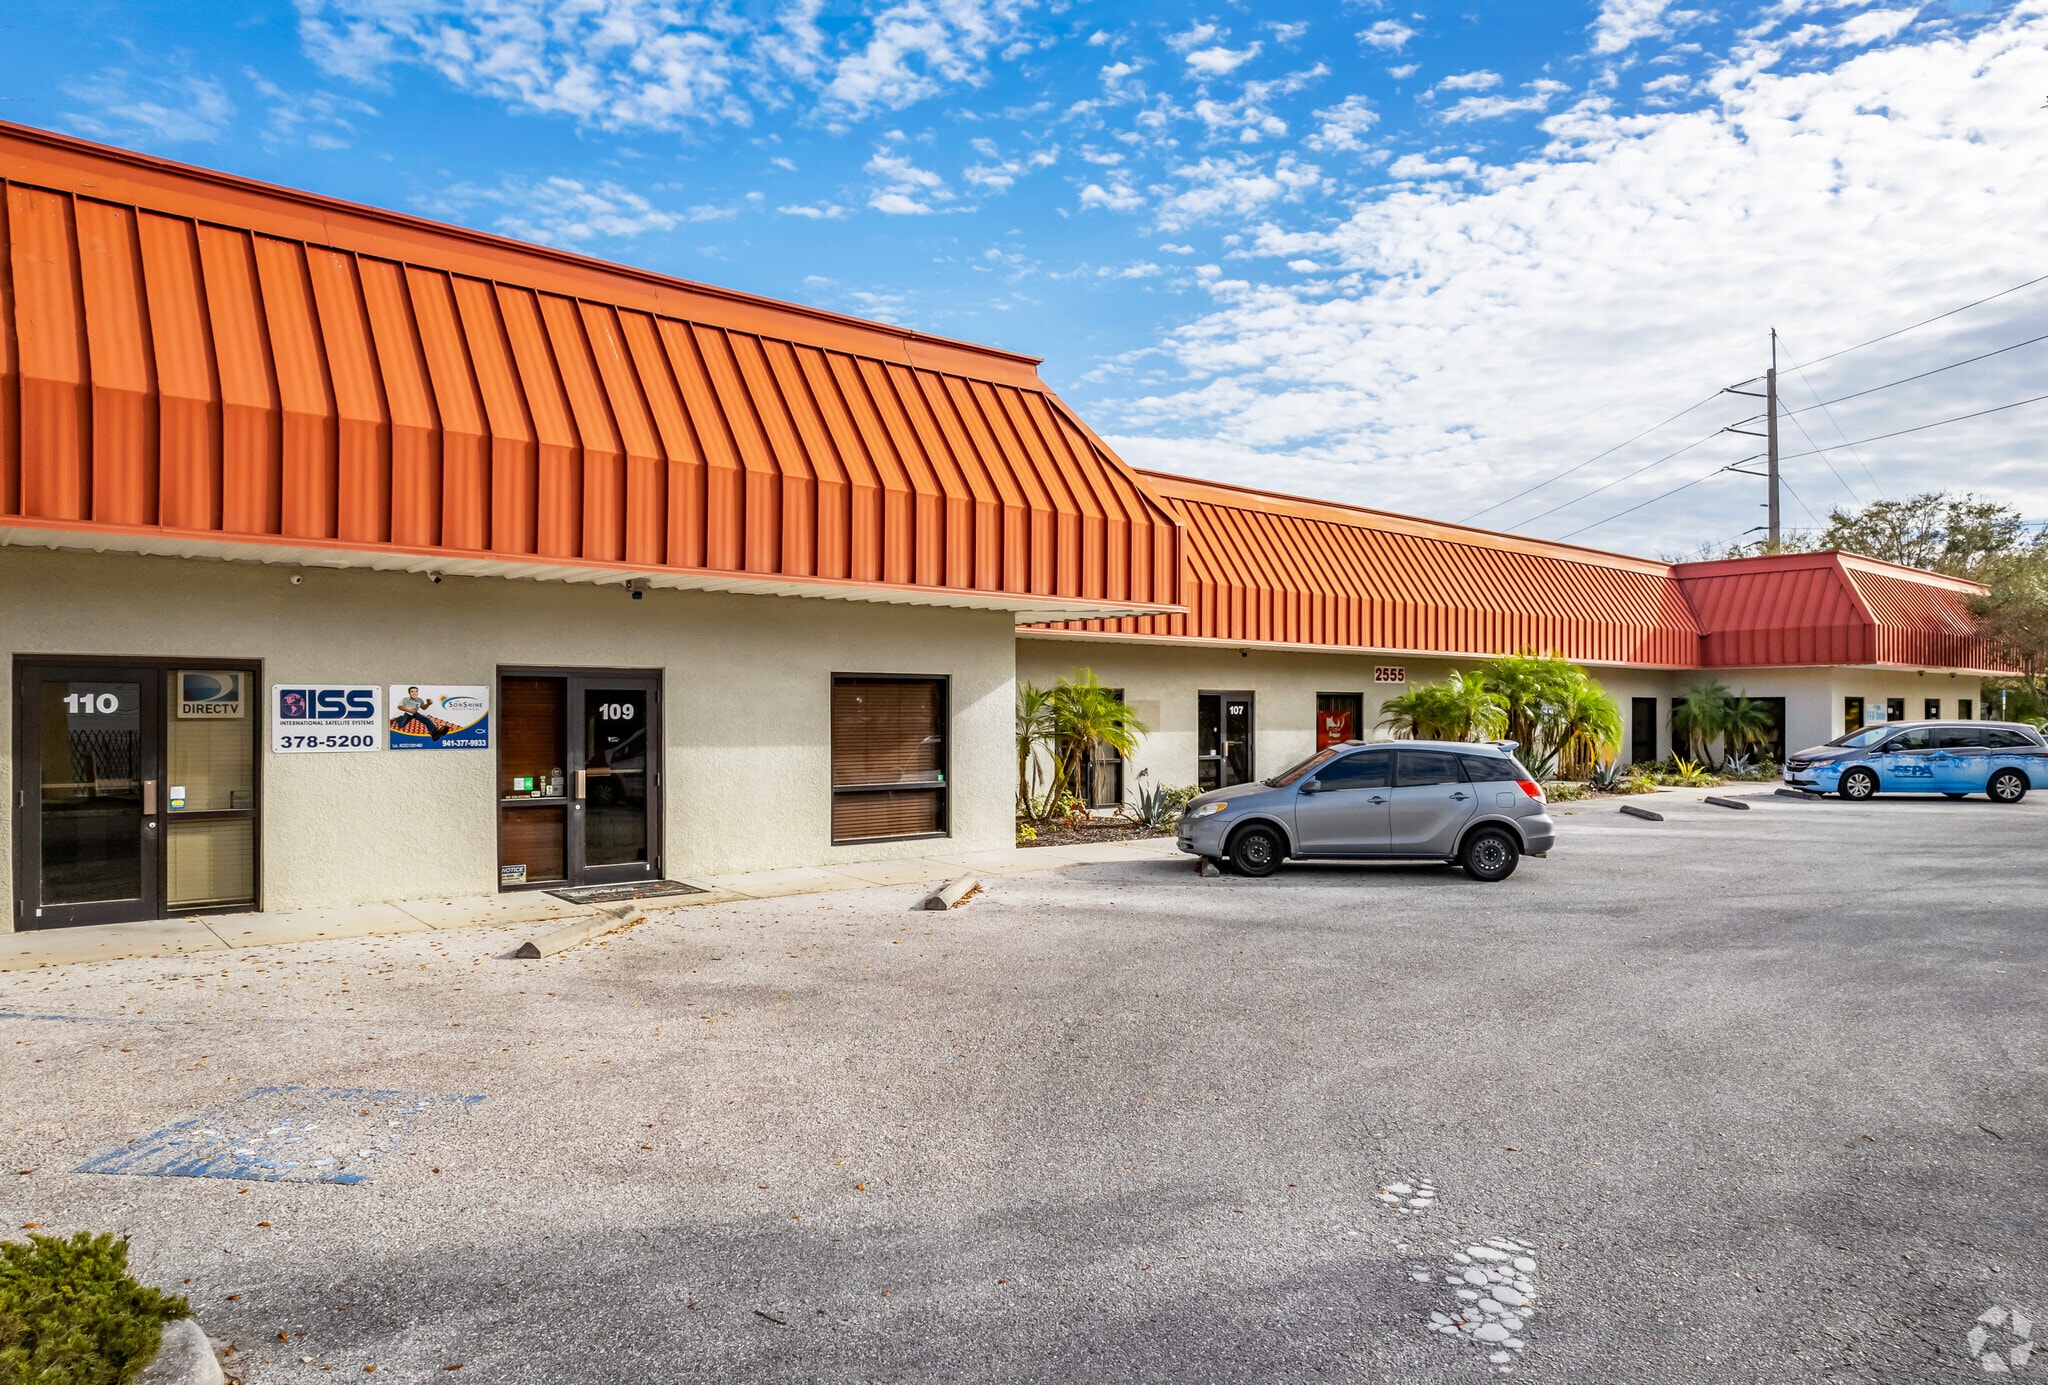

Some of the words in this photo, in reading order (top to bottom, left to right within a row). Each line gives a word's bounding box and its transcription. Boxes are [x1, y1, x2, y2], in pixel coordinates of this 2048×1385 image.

[1375, 667, 1405, 682] 2555
[63, 693, 119, 714] 110
[183, 703, 239, 714] DIRECTV
[308, 689, 375, 719] ISS
[1229, 705, 1244, 715] 107
[599, 703, 635, 720] 109
[280, 735, 374, 748] 378-5200
